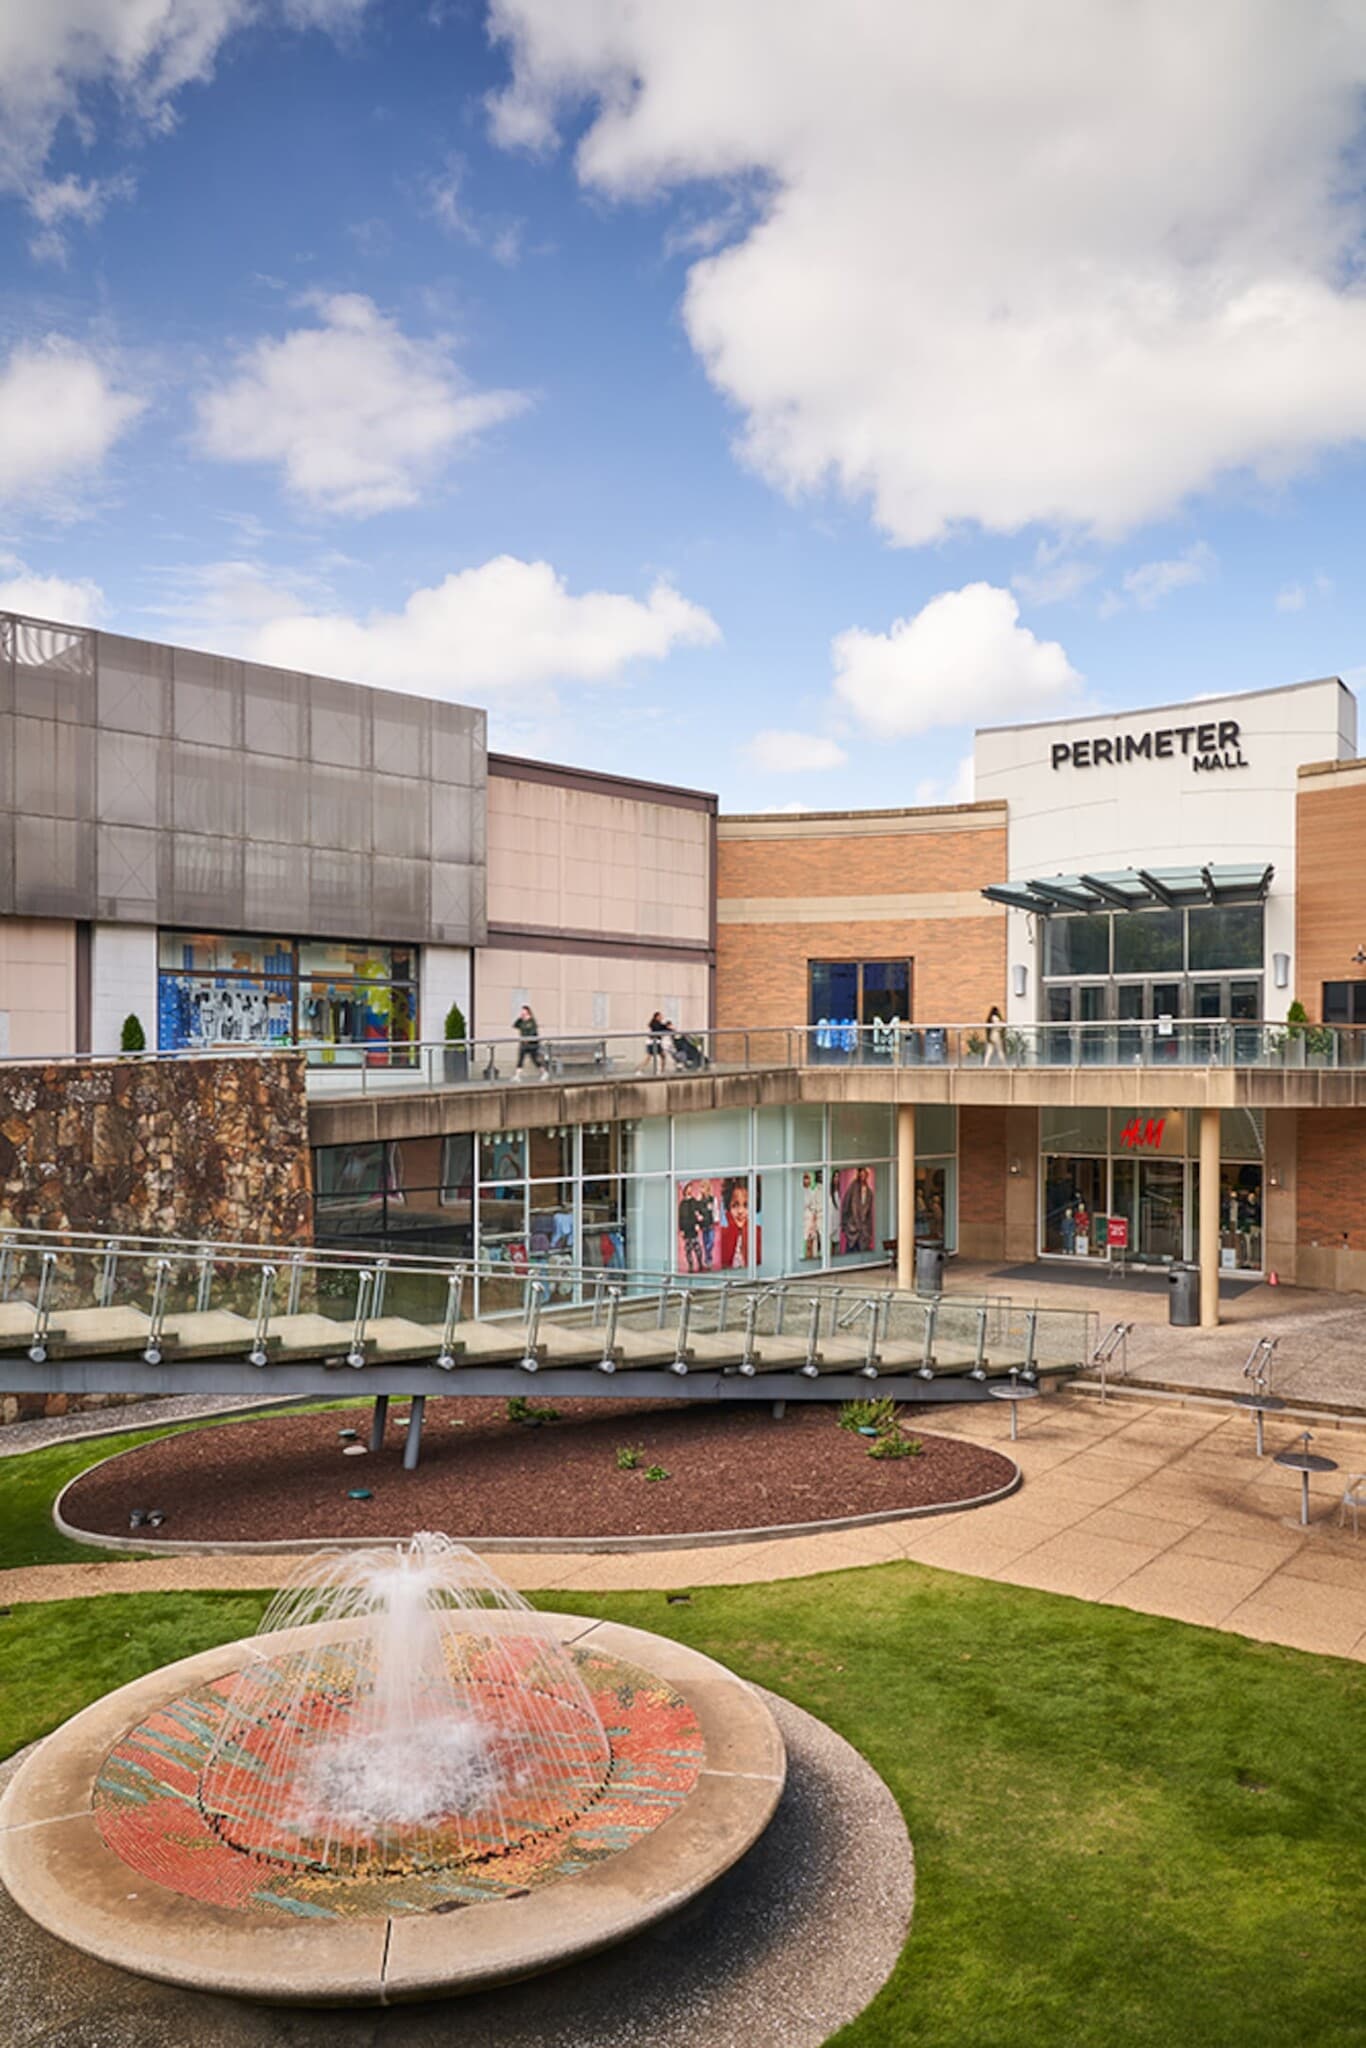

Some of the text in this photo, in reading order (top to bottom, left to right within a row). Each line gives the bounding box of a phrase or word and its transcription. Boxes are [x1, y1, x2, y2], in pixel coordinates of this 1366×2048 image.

[1051, 721, 1240, 770] PERIMETER
[1193, 751, 1248, 772] MALL
[1120, 1117, 1166, 1149] H&M
